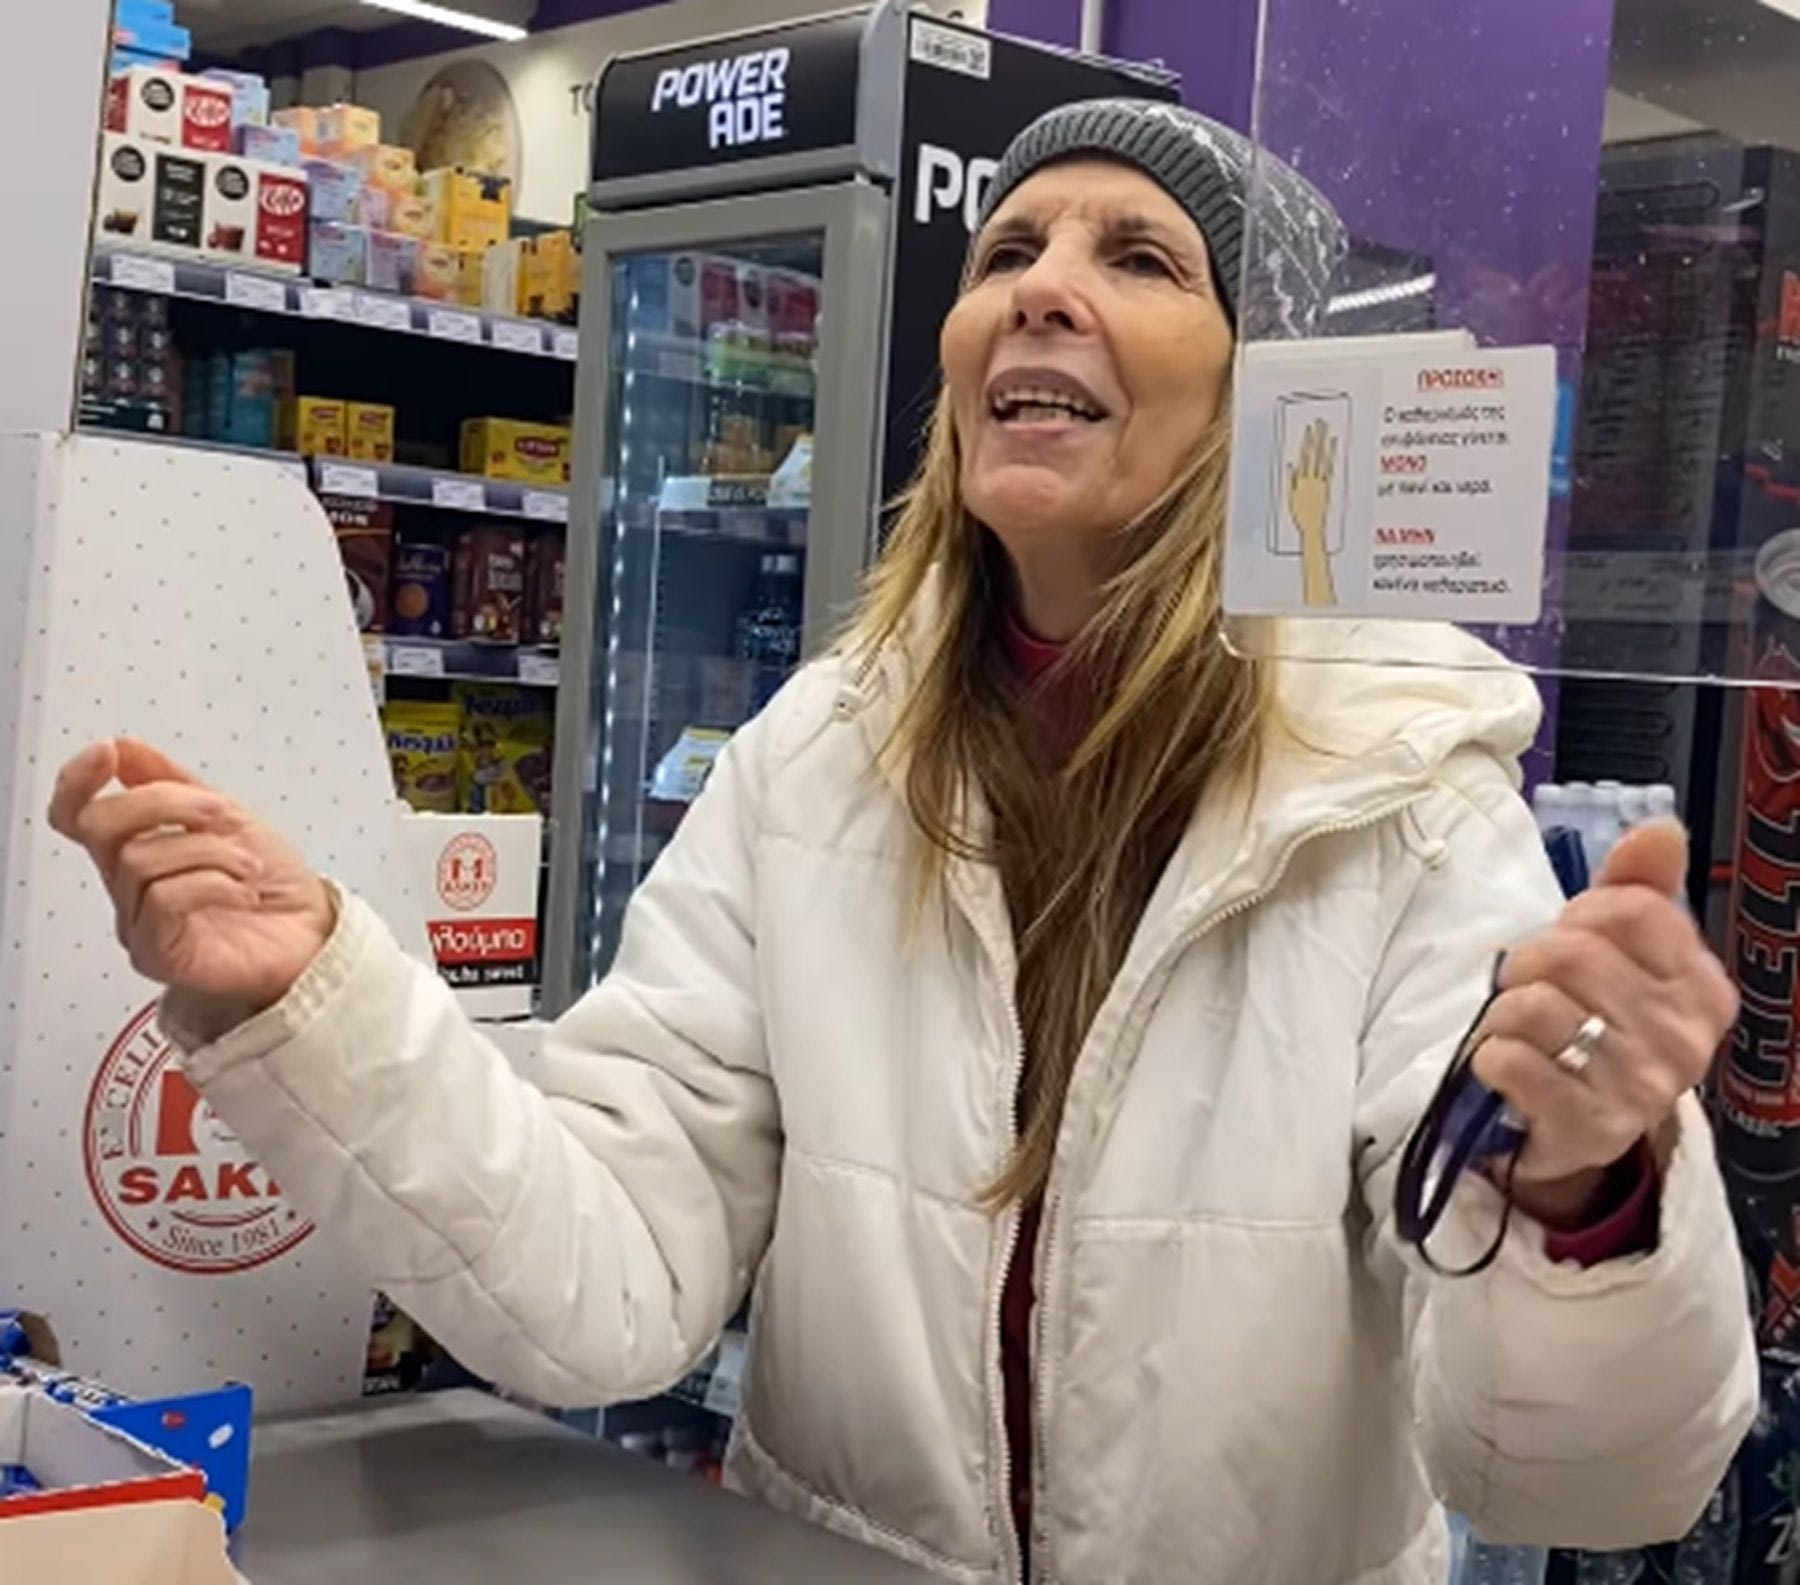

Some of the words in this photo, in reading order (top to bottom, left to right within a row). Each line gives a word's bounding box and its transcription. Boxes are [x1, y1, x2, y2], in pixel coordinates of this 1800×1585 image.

[651, 47, 790, 112] POWER
[709, 92, 785, 148] ADE
[1729, 804, 1800, 1089] HELL
[118, 1162, 282, 1206] SAK
[163, 1224, 224, 1256] Since
[231, 1218, 280, 1252] 1981
